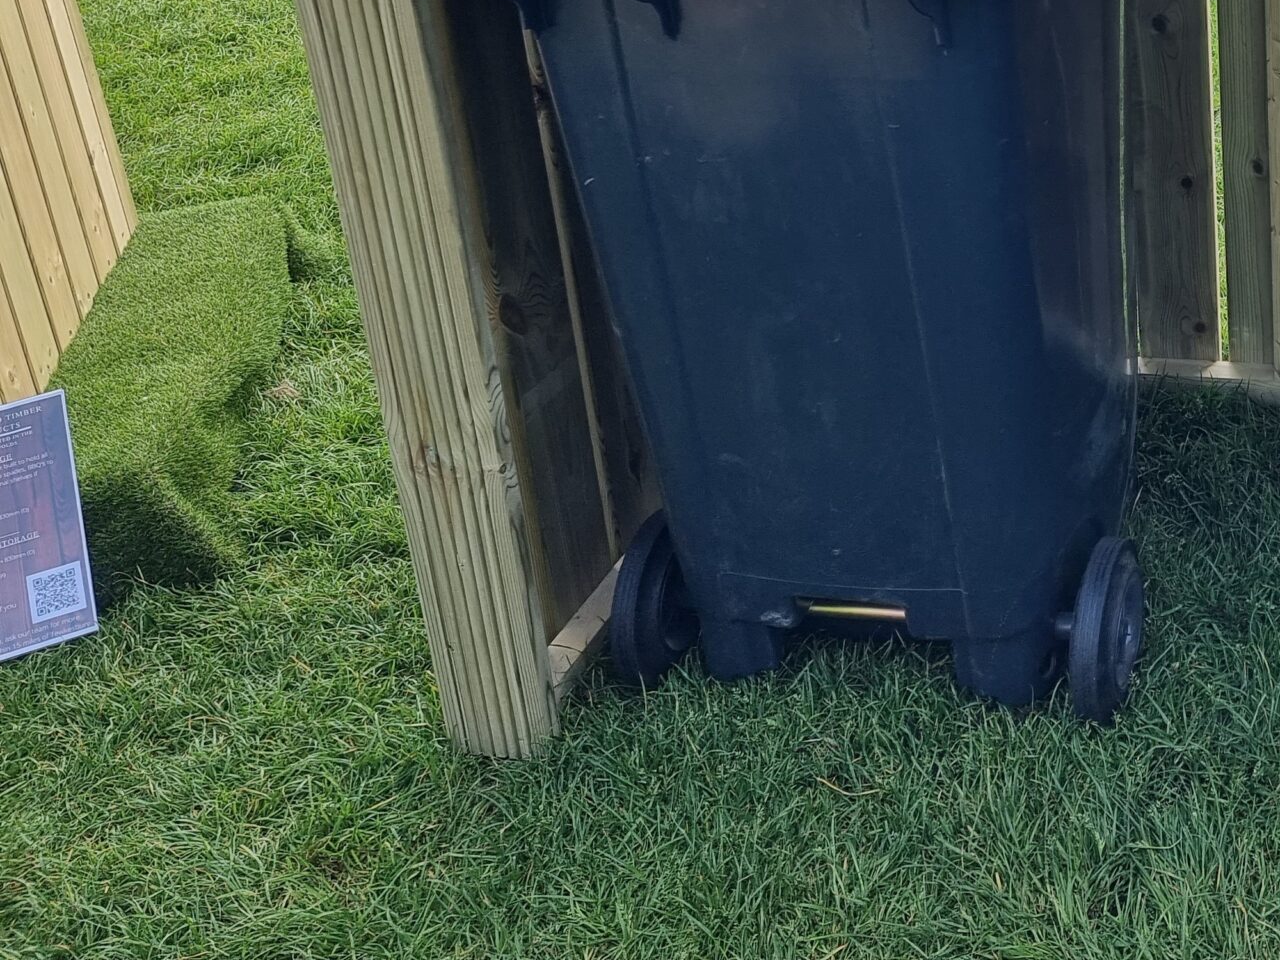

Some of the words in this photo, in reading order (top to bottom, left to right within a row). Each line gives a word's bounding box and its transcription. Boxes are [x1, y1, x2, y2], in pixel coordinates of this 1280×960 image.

[5, 405, 42, 421] TIMBER
[4, 603, 17, 613] you
[17, 630, 31, 639] our
[31, 624, 49, 634] team
[50, 620, 60, 629] for
[61, 615, 81, 625] more
